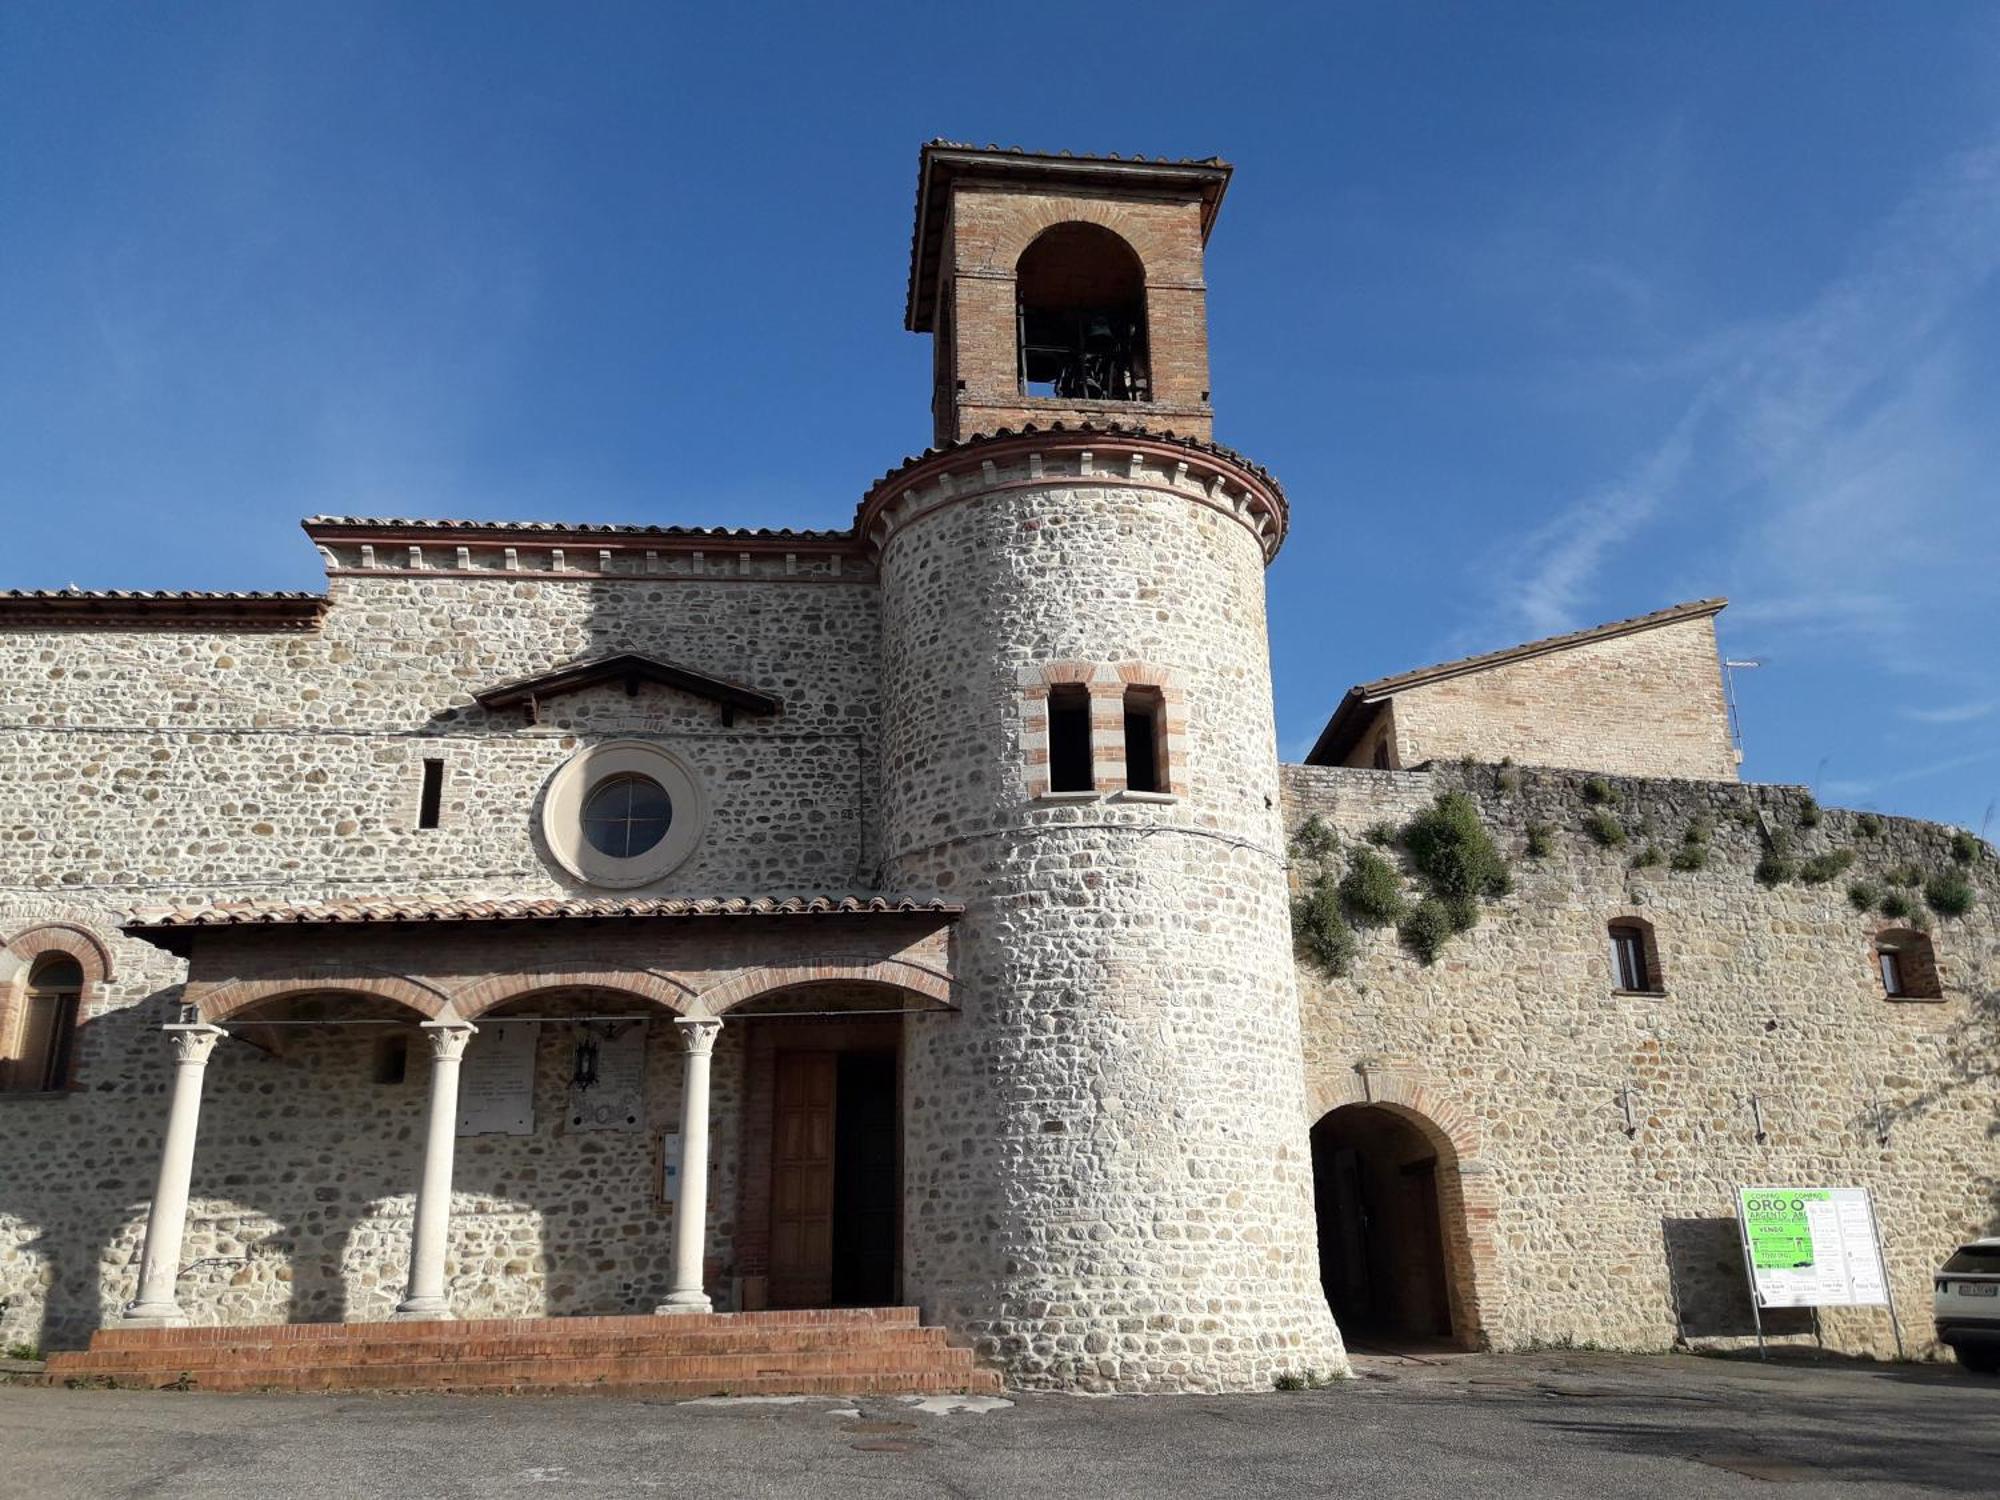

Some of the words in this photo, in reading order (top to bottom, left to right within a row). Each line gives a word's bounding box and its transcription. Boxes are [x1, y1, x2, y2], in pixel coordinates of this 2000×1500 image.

[1750, 1192, 1780, 1200] COMPRO
[1794, 1192, 1823, 1200] COMPRO
[1747, 1199, 1787, 1211] ORO
[1750, 1211, 1788, 1219] ARGENTO
